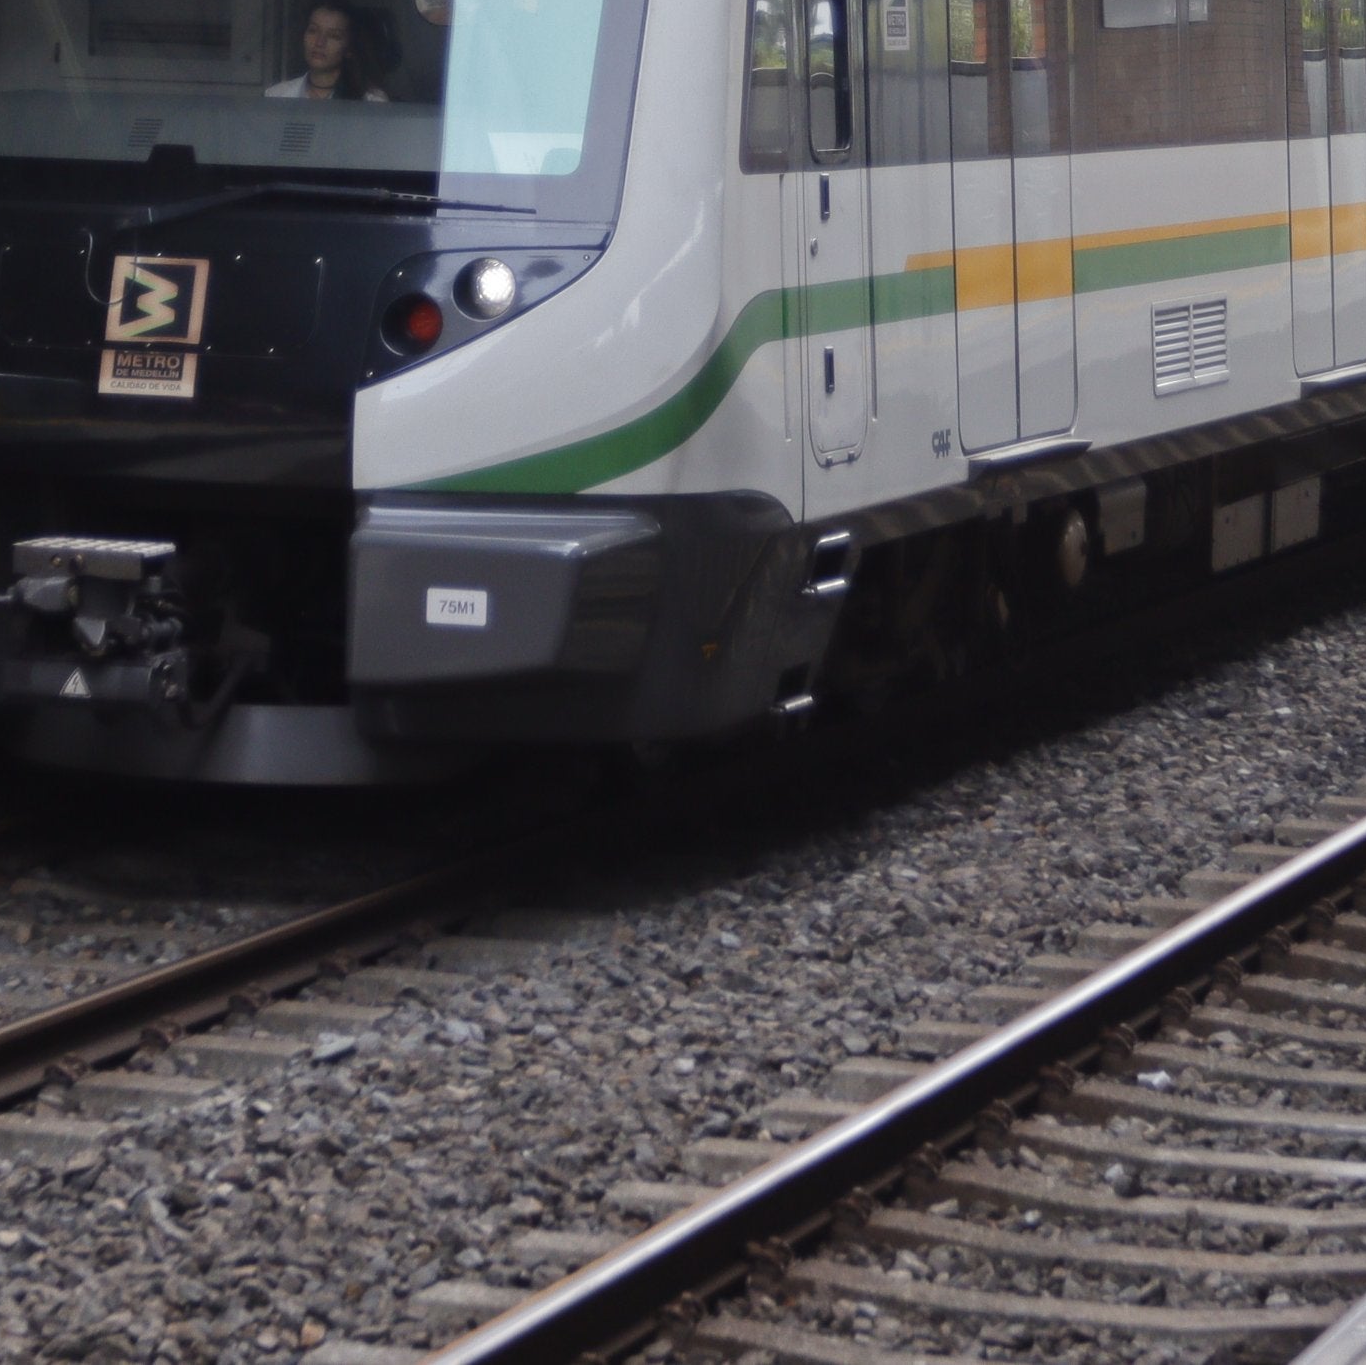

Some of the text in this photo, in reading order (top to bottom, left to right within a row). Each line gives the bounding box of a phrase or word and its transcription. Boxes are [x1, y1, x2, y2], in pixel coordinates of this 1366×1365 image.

[116, 353, 181, 369] METRO
[115, 368, 128, 377] DE
[110, 380, 182, 392] CALIDAD DE VIDA
[439, 599, 475, 615] 75M1
